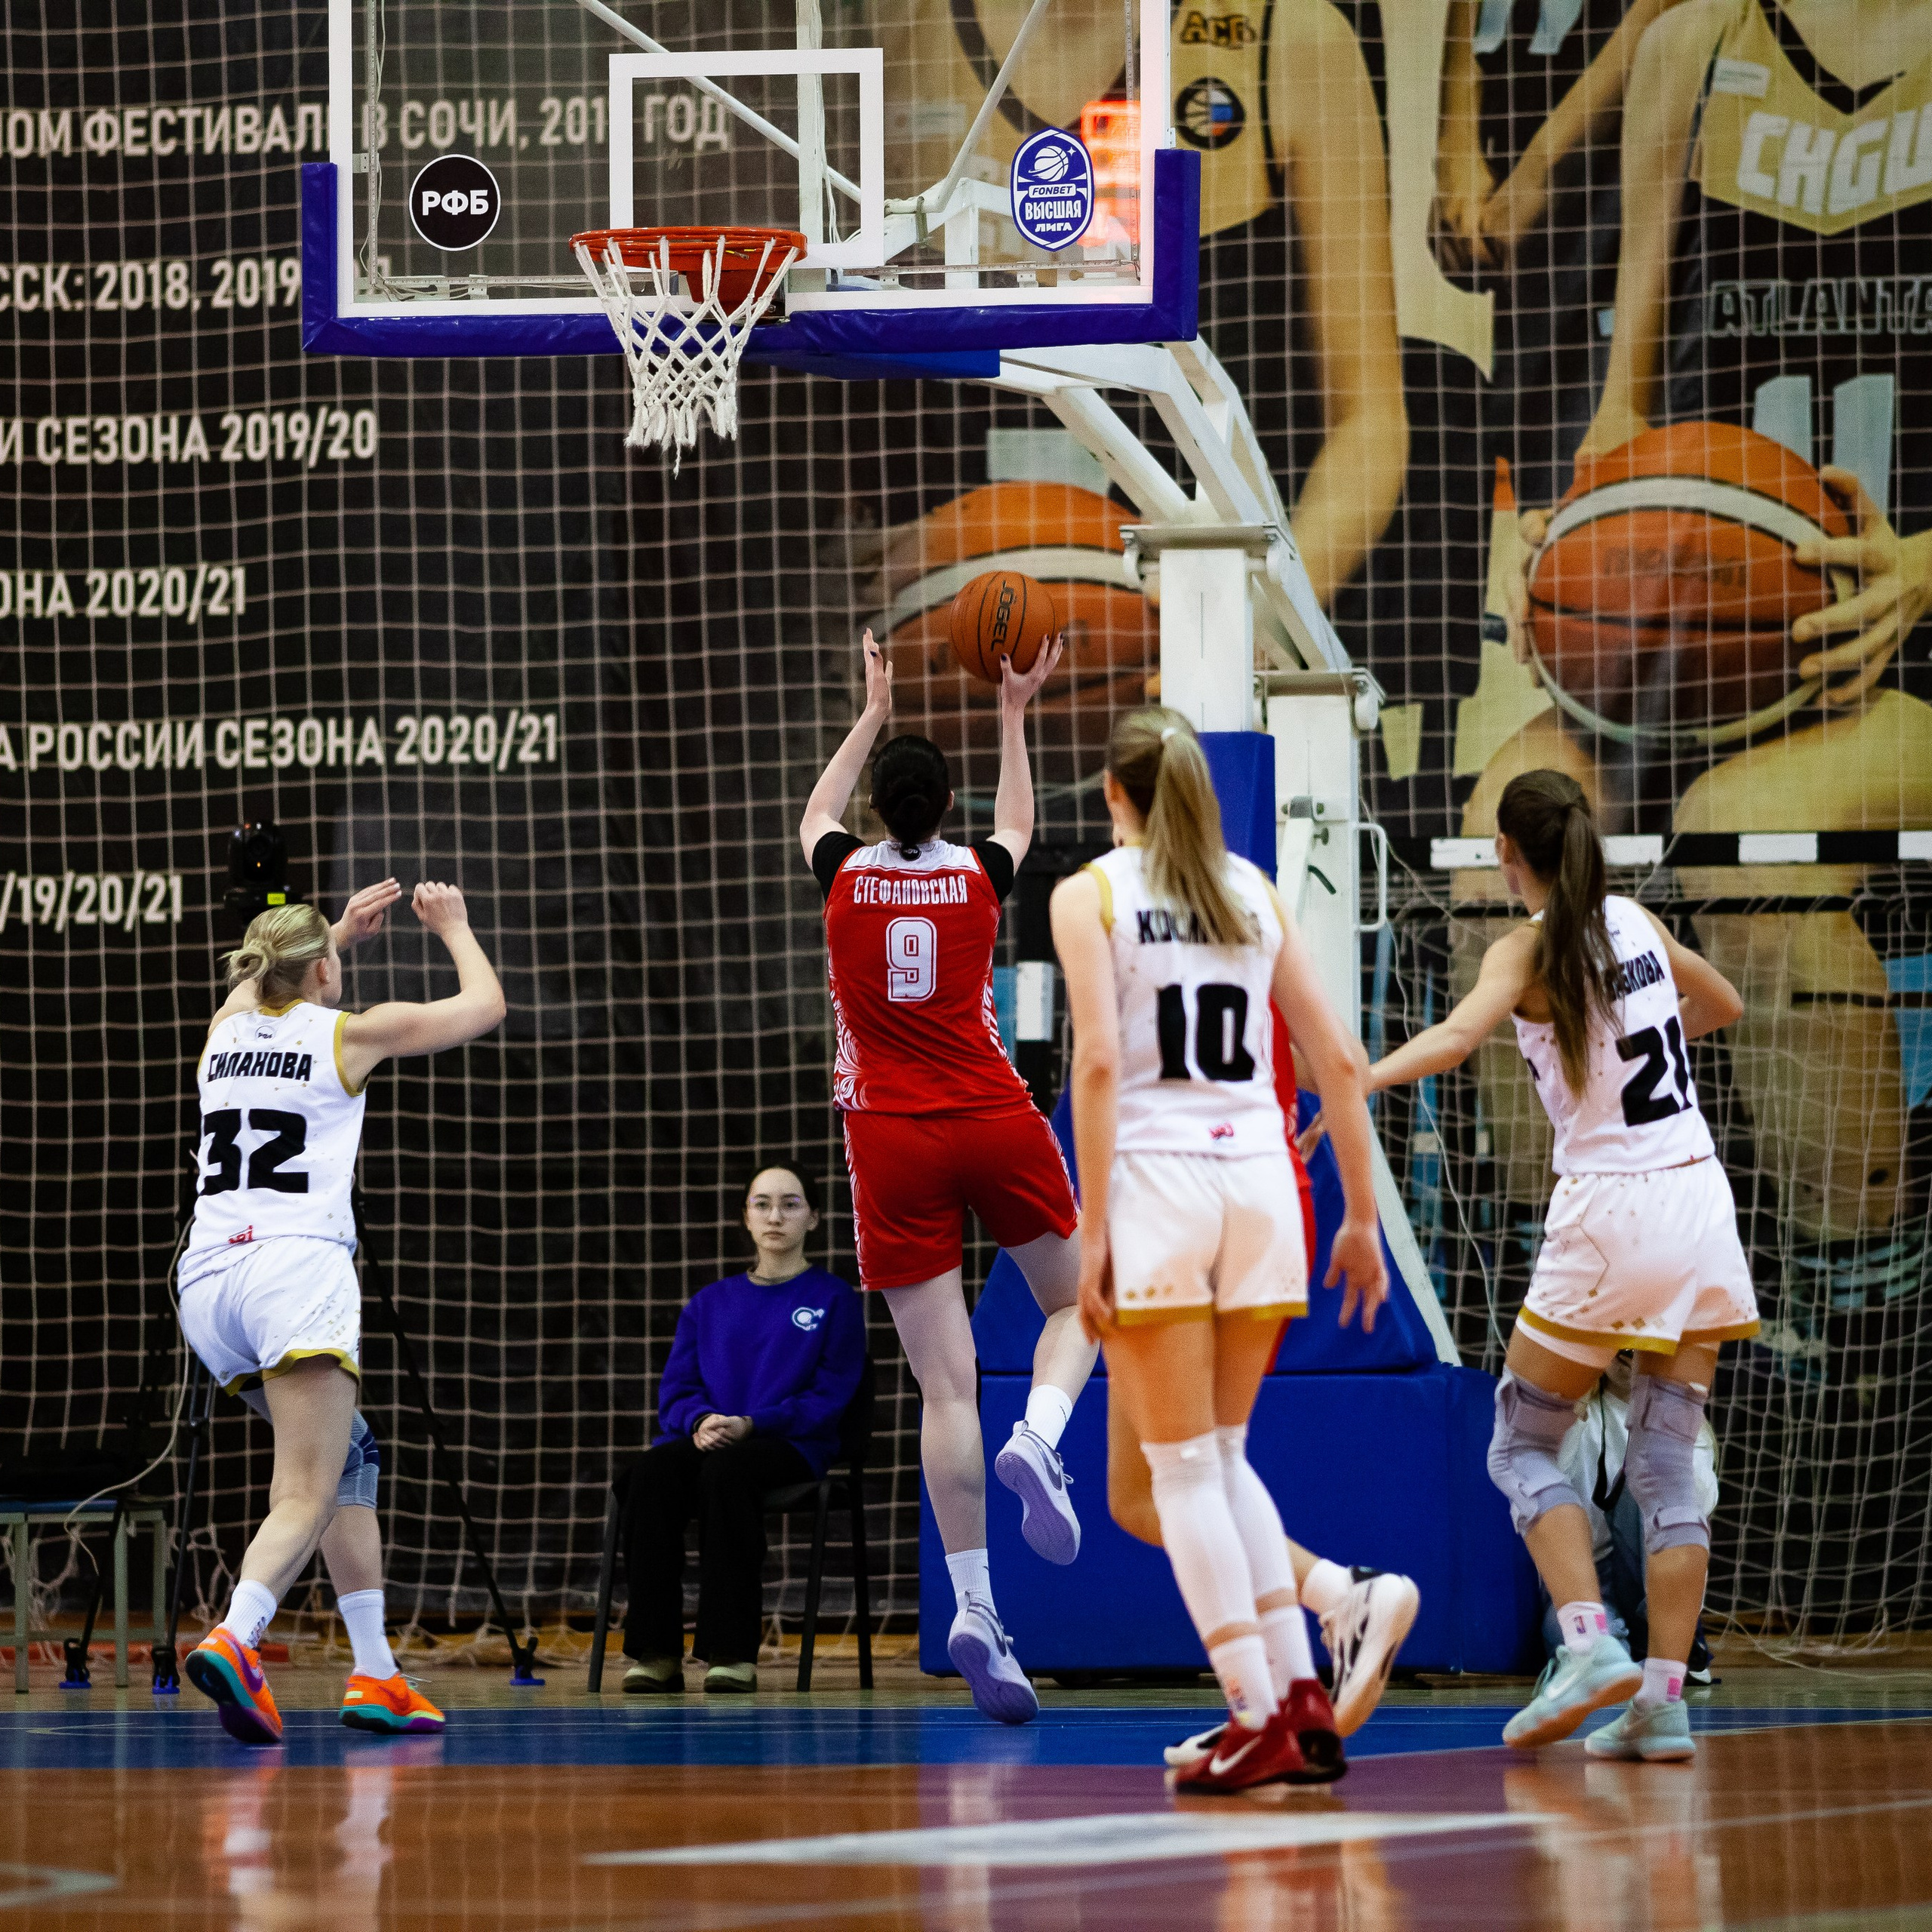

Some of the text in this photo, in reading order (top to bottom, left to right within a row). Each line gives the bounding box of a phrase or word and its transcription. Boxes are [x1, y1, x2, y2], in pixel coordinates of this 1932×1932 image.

[0, 104, 72, 159] ОМ
[82, 103, 330, 157] ФЕСТИВАЛ
[399, 98, 528, 151] СОЧИ,
[539, 95, 605, 146] 201
[643, 94, 729, 152] ГОД
[422, 189, 489, 216] РФБ
[1024, 200, 1081, 220] ВЫСШАЯ
[1032, 186, 1072, 196] FONBET
[1035, 223, 1072, 232] ЛИГА
[94, 260, 202, 314] 2018,
[211, 257, 302, 309] 2019
[35, 413, 211, 465] СЕЗОНА
[219, 405, 378, 468] 2019/20
[86, 562, 247, 625] 2020/21
[28, 720, 204, 772] РОССИИ
[215, 716, 386, 769] СЕЗОНА
[395, 709, 557, 773] 2020/21
[854, 874, 968, 905] СТЕФАНОВСКАЯ
[885, 916, 937, 1002] 9
[1155, 982, 1256, 1082] 10
[1615, 1015, 1693, 1128] 21
[199, 1108, 309, 1196] 32
